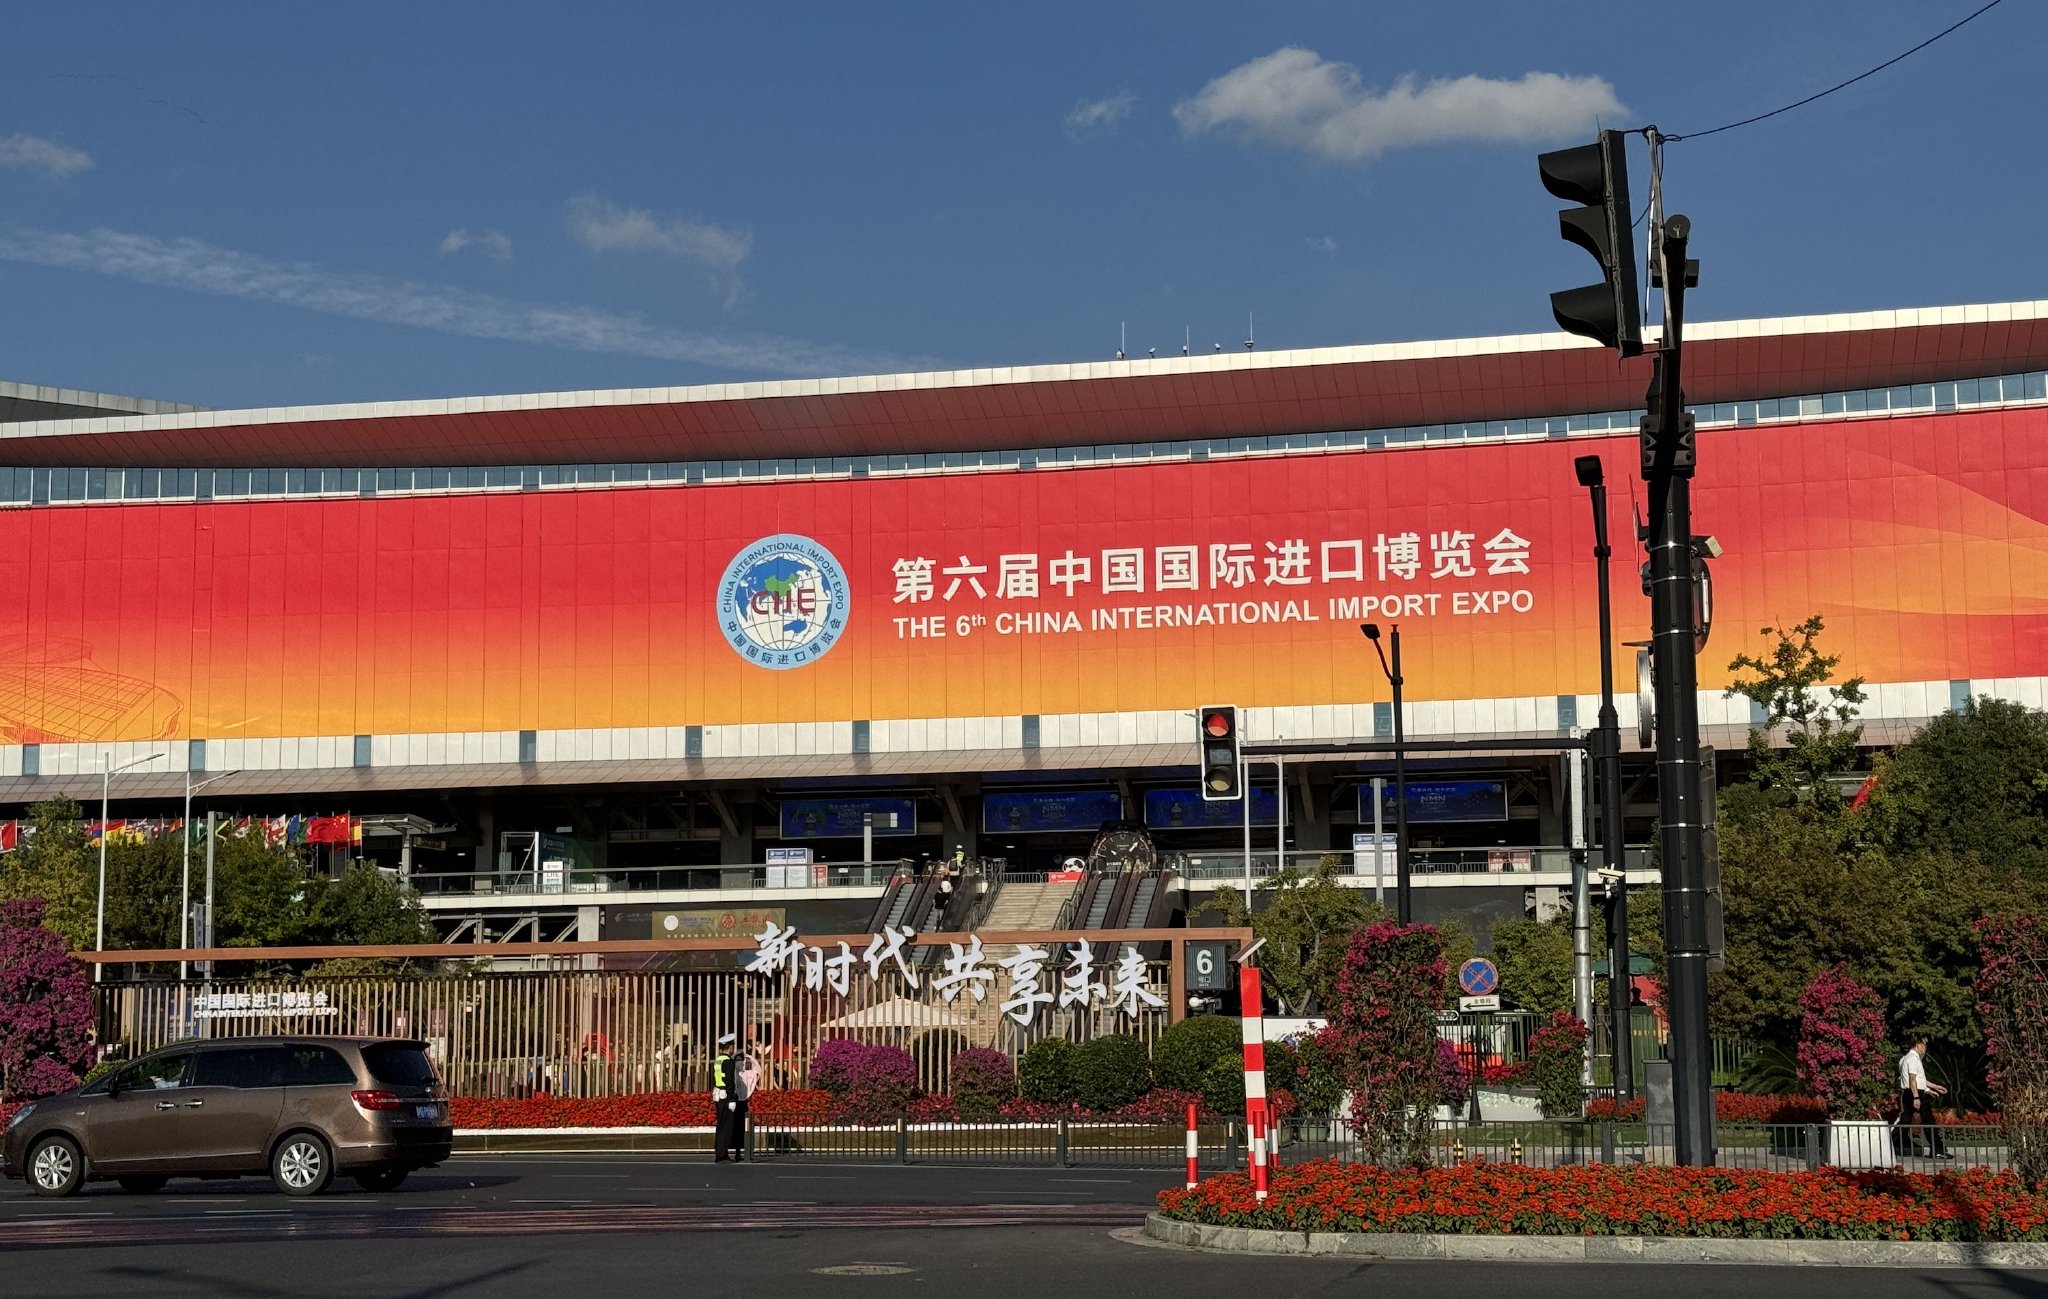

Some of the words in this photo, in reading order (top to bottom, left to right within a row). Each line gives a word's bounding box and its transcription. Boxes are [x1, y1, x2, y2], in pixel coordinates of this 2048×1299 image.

[724, 581, 736, 613] CHINA
[732, 542, 805, 580] INTERNATIONAL
[807, 548, 838, 579] IMPORT
[833, 581, 844, 610] EXPO
[892, 528, 1532, 603] 第六届中国国际进口博览会
[893, 616, 946, 639] THE
[956, 613, 987, 637] 6th
[995, 610, 1083, 635] CHINA
[1091, 600, 1320, 632] INTERNATIONAL
[1329, 593, 1442, 620] IMPORT
[1452, 589, 1534, 615] EXPO
[727, 618, 842, 665] 中国国际进口博览会
[745, 921, 919, 998] 新时代
[931, 934, 1168, 1027] 共享未来
[1196, 949, 1213, 974] 6
[194, 990, 329, 1010] 中国国际进口博览会
[194, 1009, 217, 1018] CHINA
[218, 1008, 282, 1018] INTERNATIONAL
[282, 1007, 314, 1017] IMPORT
[315, 1007, 338, 1016] EXPO
